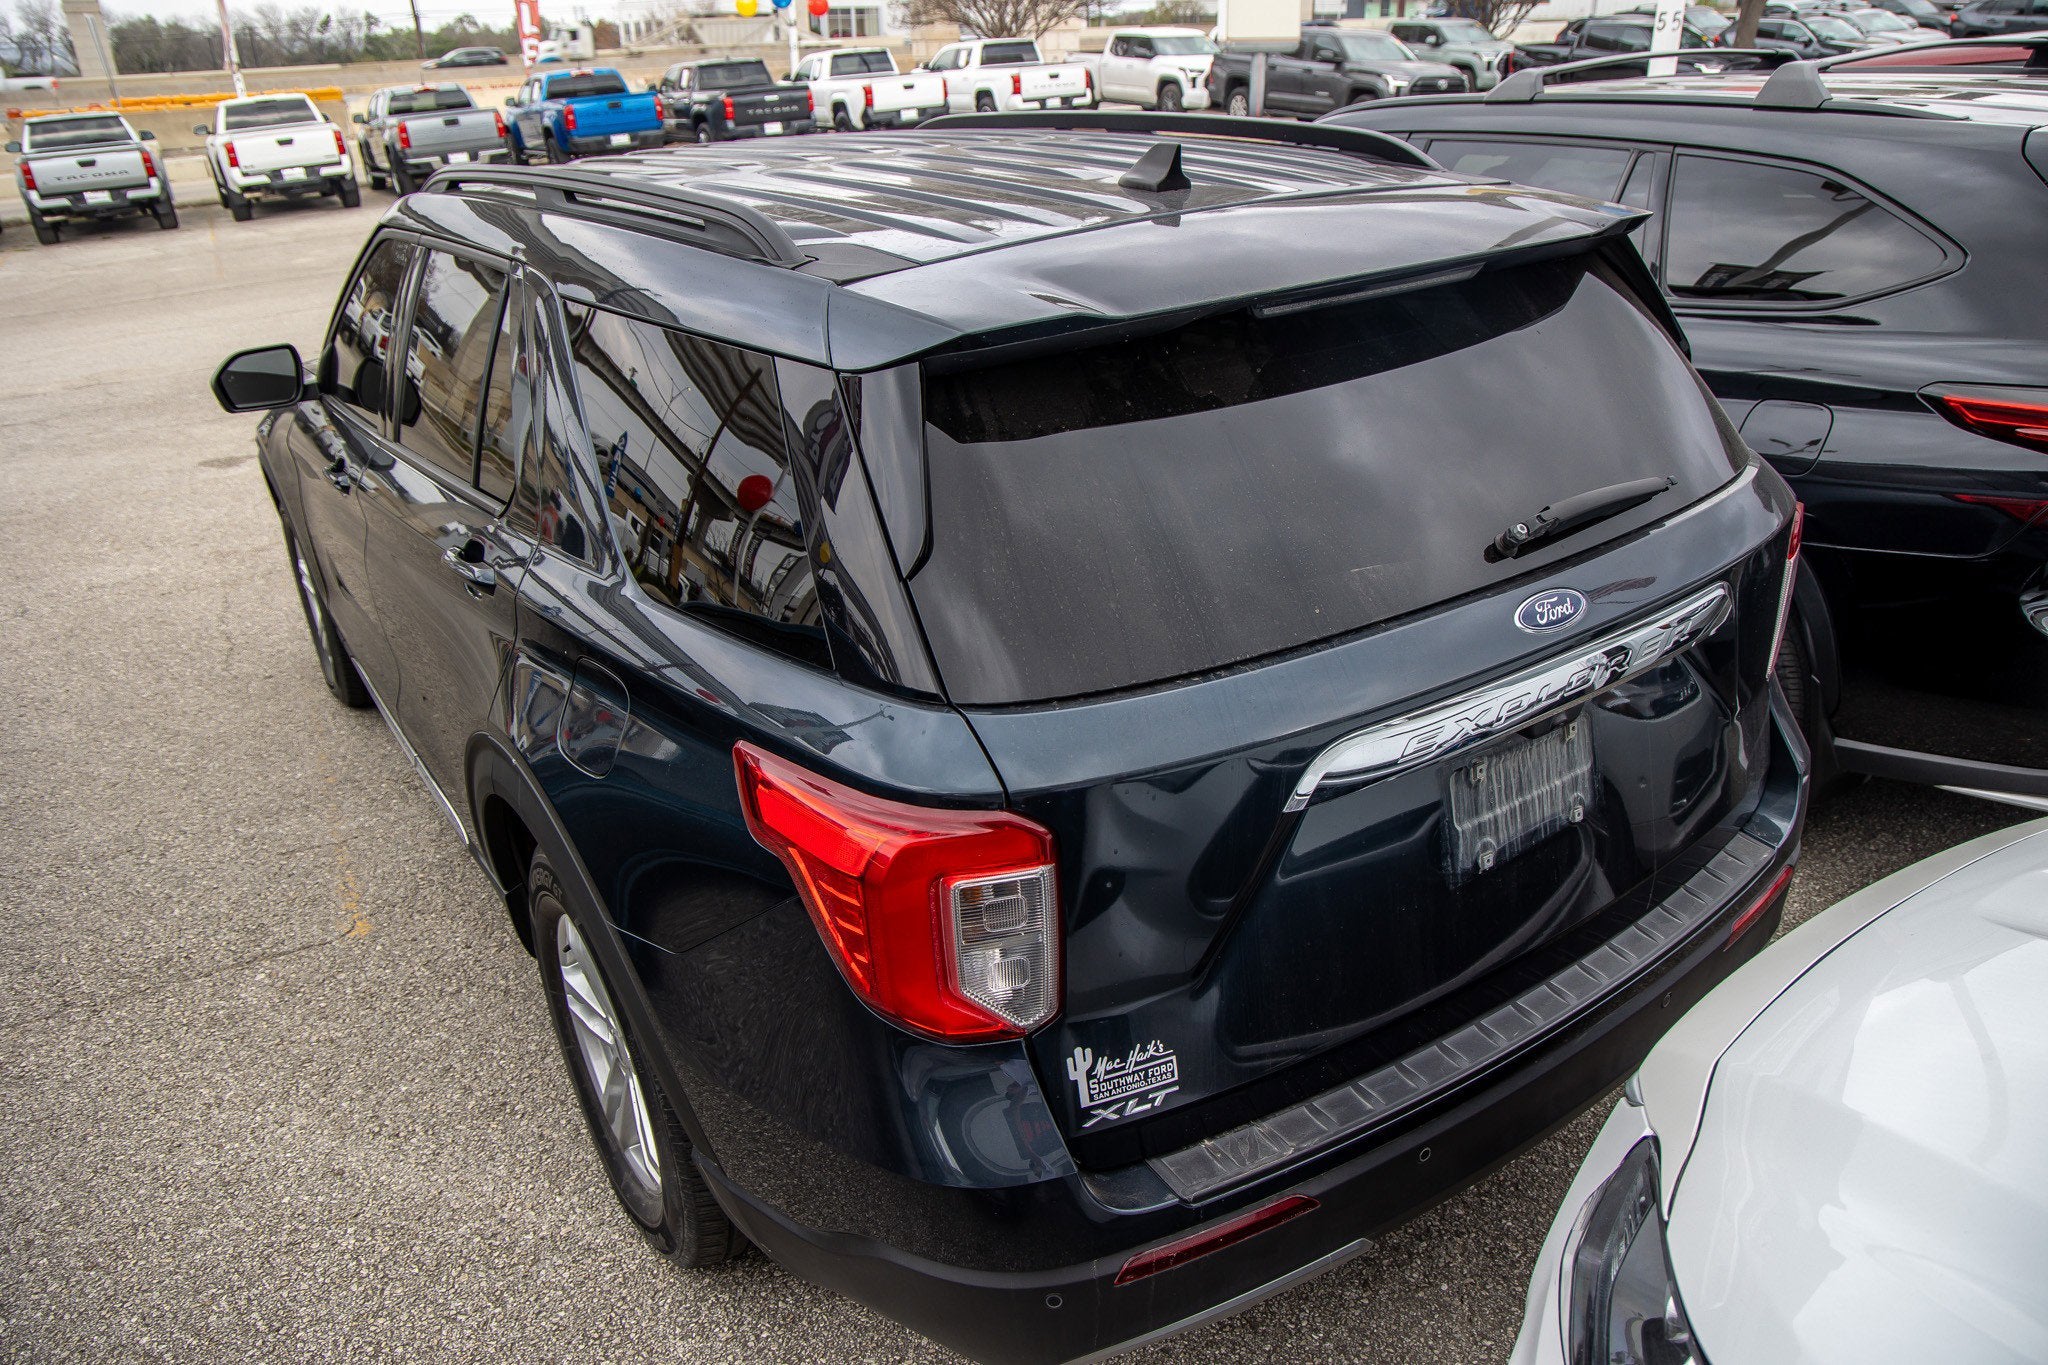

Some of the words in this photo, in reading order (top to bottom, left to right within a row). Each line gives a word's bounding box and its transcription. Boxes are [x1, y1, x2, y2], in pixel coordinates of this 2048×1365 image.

[746, 104, 800, 116] TACOMA
[53, 169, 130, 182] TACOMA
[1534, 596, 1575, 626] Ford
[1397, 616, 1694, 764] EXPLORER
[1091, 1056, 1127, 1082] Mac
[1125, 1040, 1174, 1073] Haik's
[1089, 1070, 1145, 1094] SOUTHWAY
[1147, 1062, 1174, 1078] FORD
[1081, 1085, 1180, 1128] XLT
[1093, 1090, 1110, 1101] SAN
